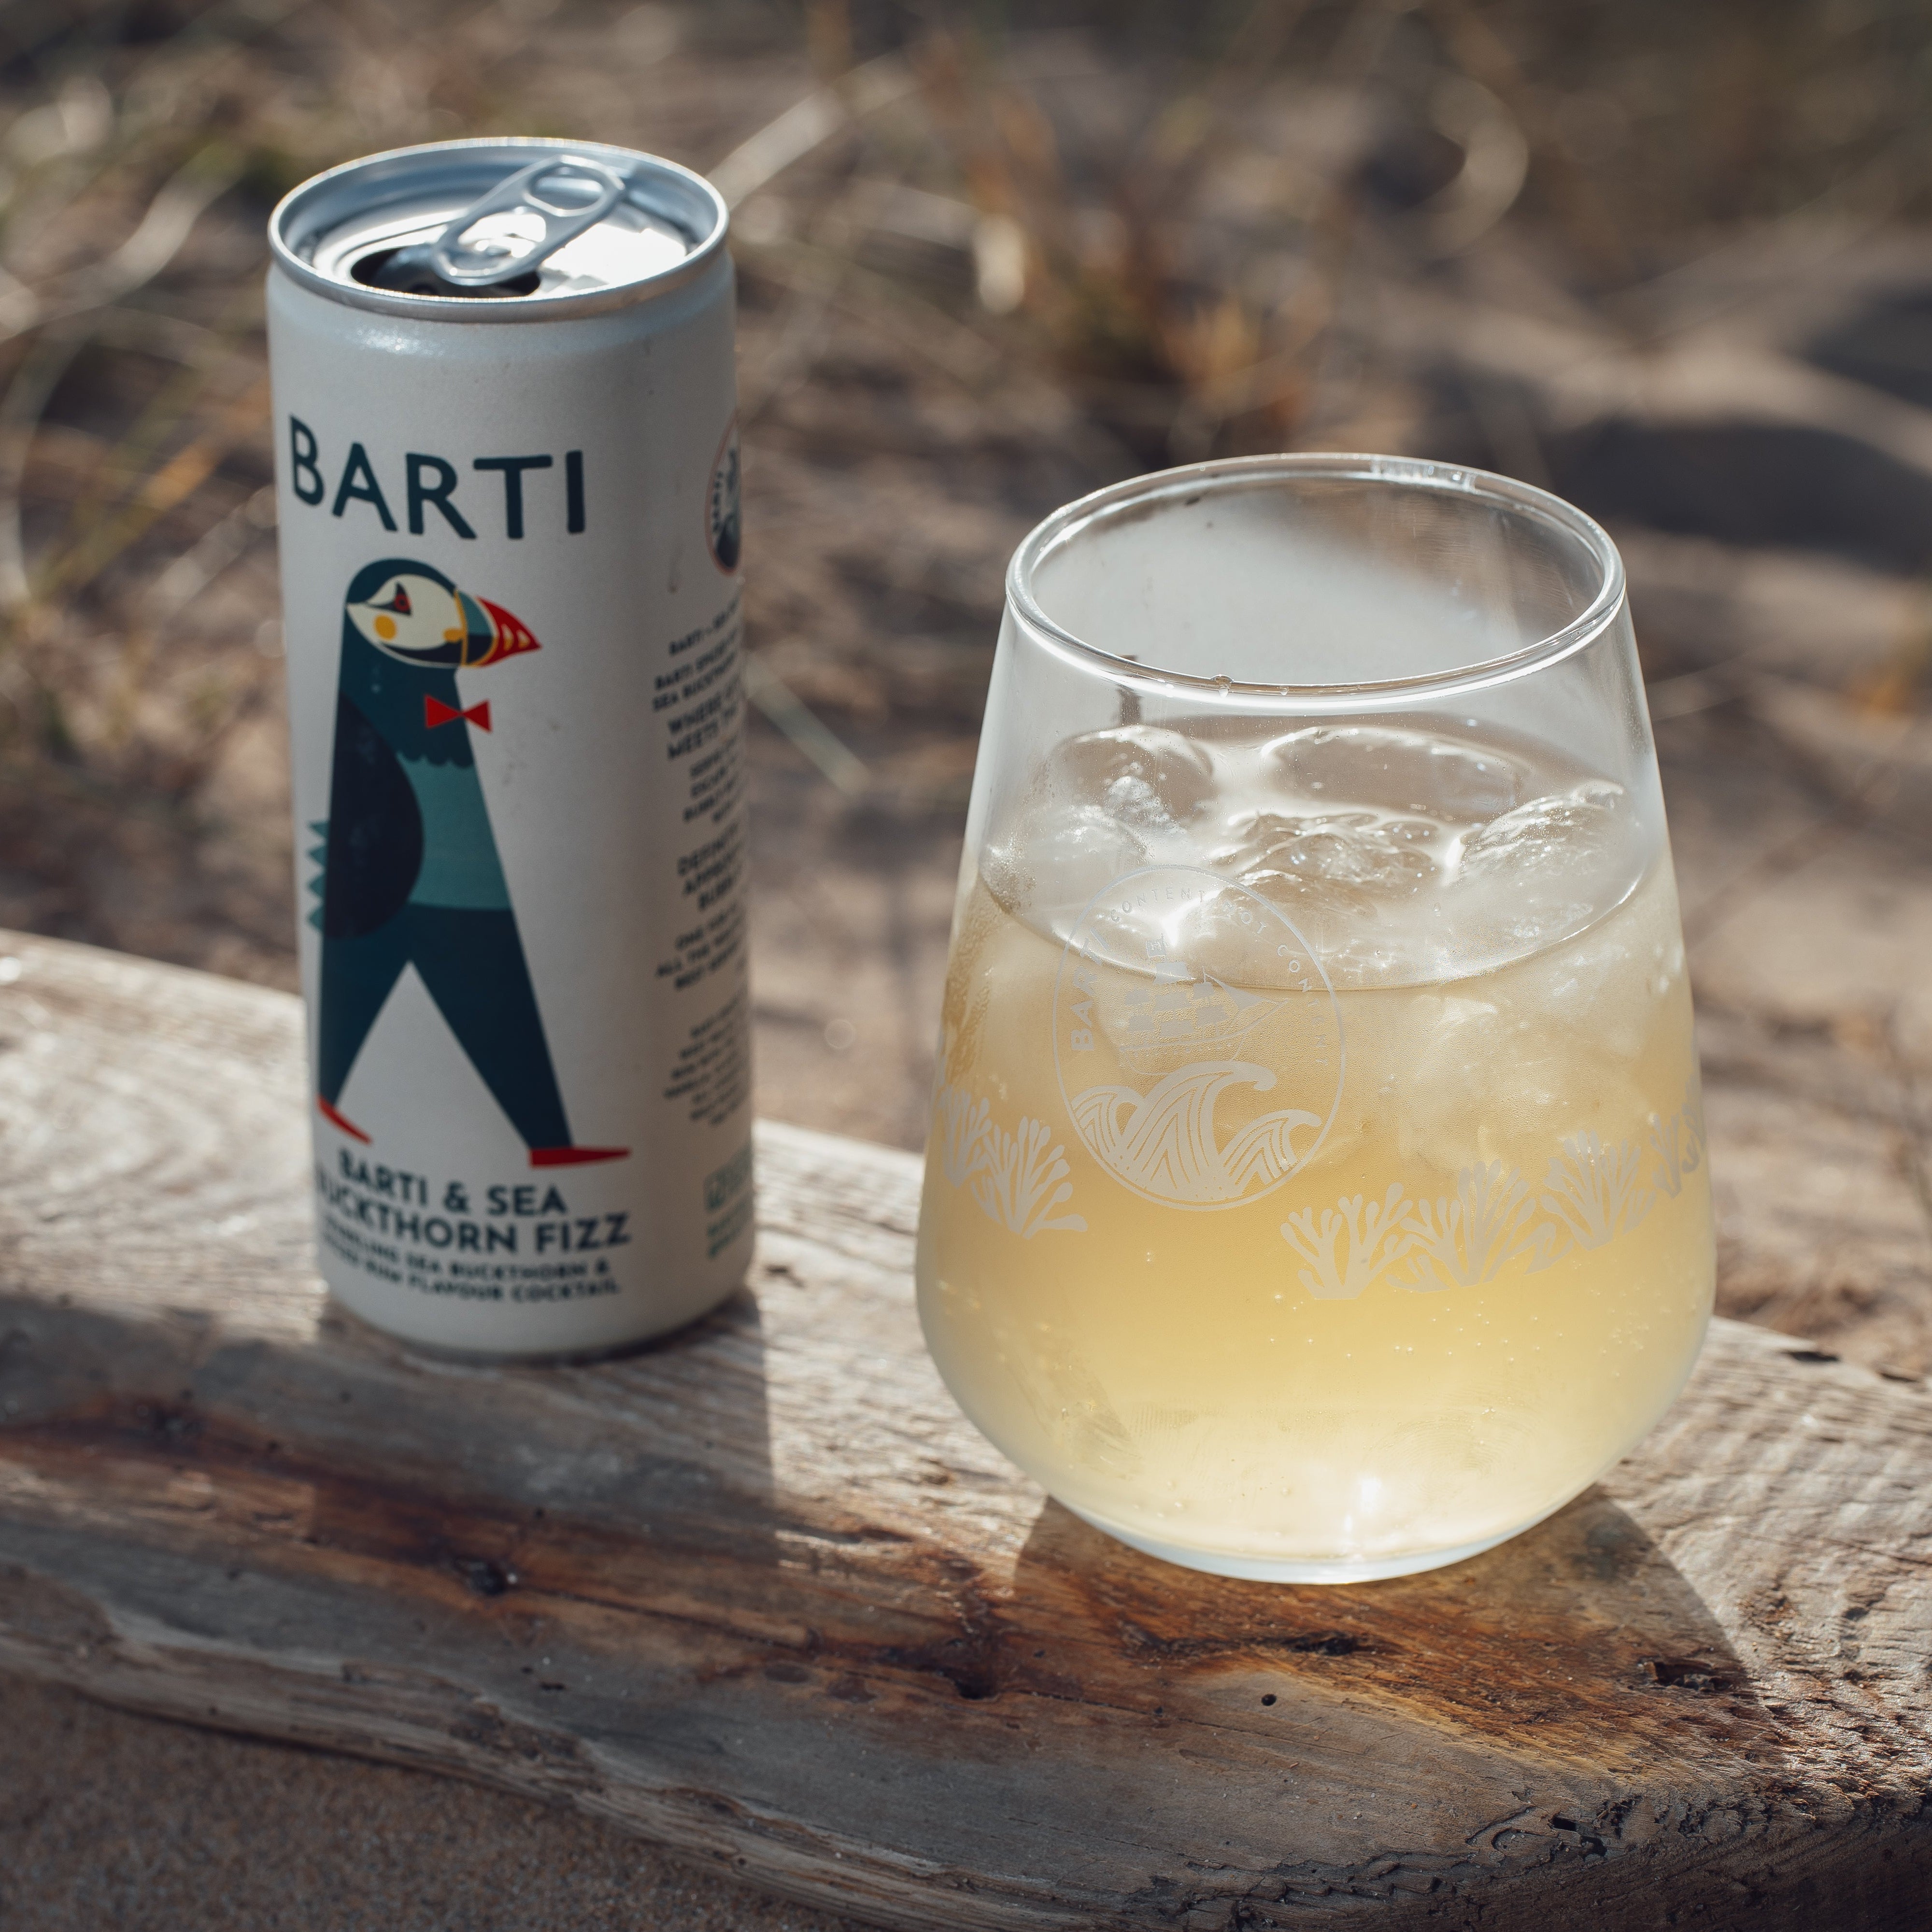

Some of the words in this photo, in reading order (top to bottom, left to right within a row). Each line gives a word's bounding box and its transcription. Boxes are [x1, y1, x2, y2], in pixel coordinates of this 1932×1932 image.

[289, 413, 586, 540] BARTI
[1110, 887, 1208, 923] CONTENT
[1222, 900, 1267, 936] NOT
[1070, 927, 1111, 1051] BARTI
[339, 1148, 428, 1208] BARTI
[443, 1180, 471, 1214] &
[486, 1183, 569, 1218] SEA
[535, 1210, 632, 1256] FIZZ
[449, 1258, 588, 1282] BUCKTHORN
